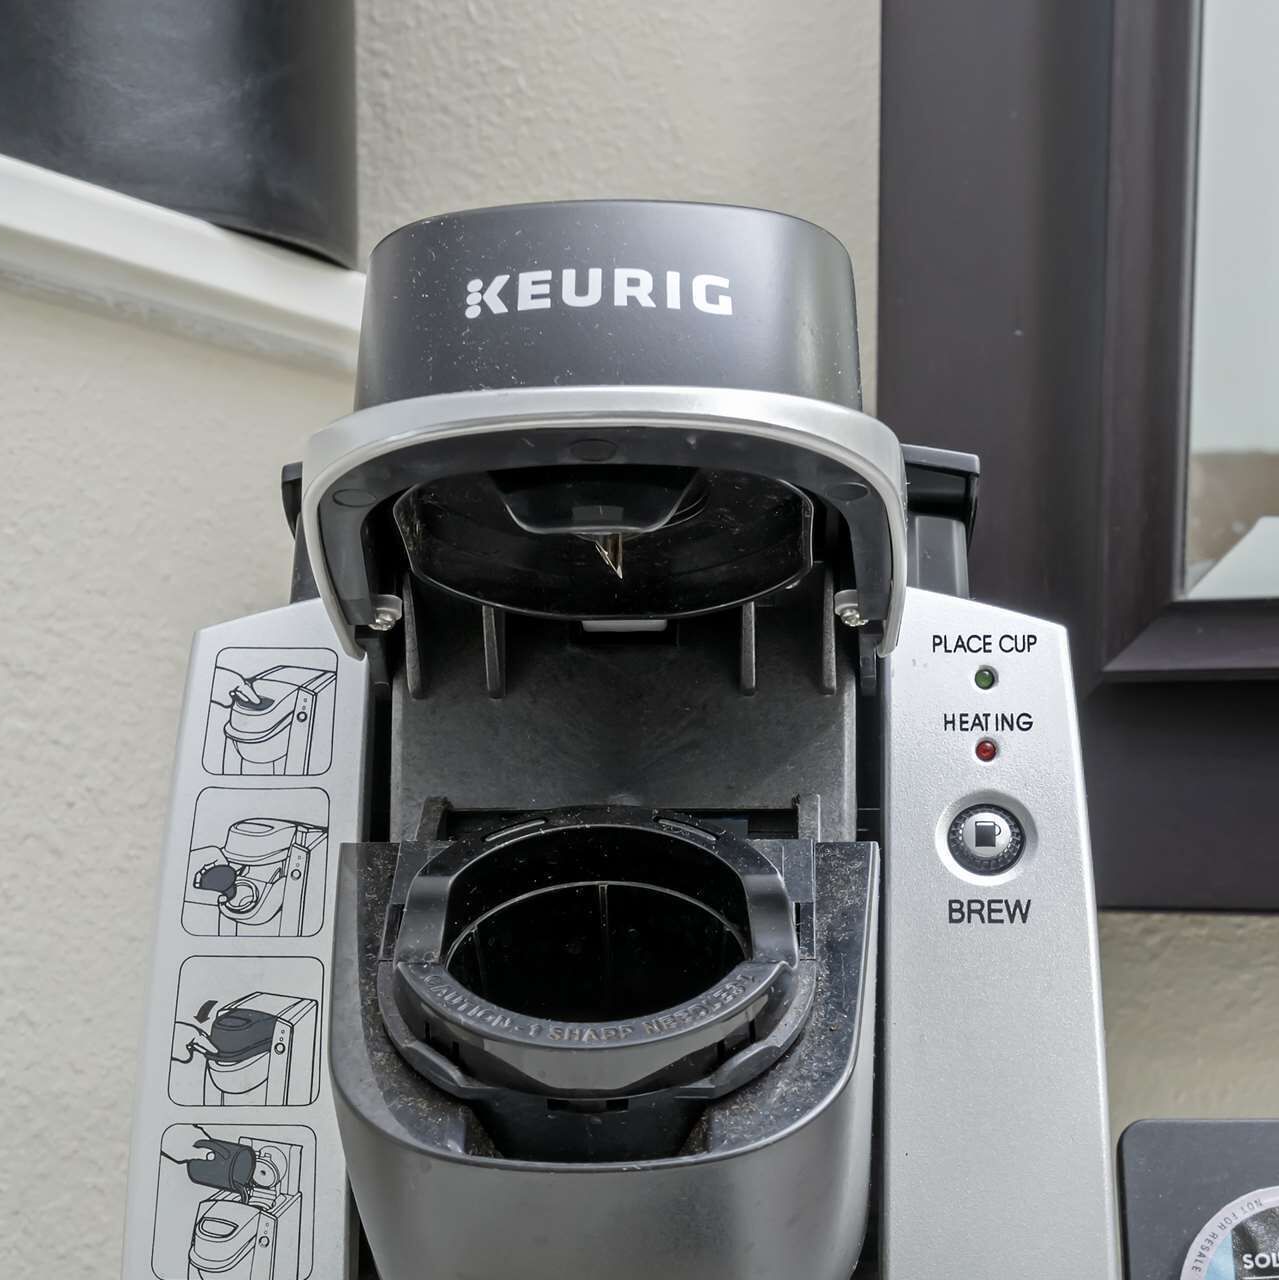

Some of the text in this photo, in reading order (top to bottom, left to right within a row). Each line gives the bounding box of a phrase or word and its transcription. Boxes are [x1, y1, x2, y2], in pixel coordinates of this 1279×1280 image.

[465, 268, 733, 319] KEURIG
[933, 634, 1037, 653] PLACE CUP
[944, 713, 1033, 731] HEATING
[948, 899, 1031, 924] BREW
